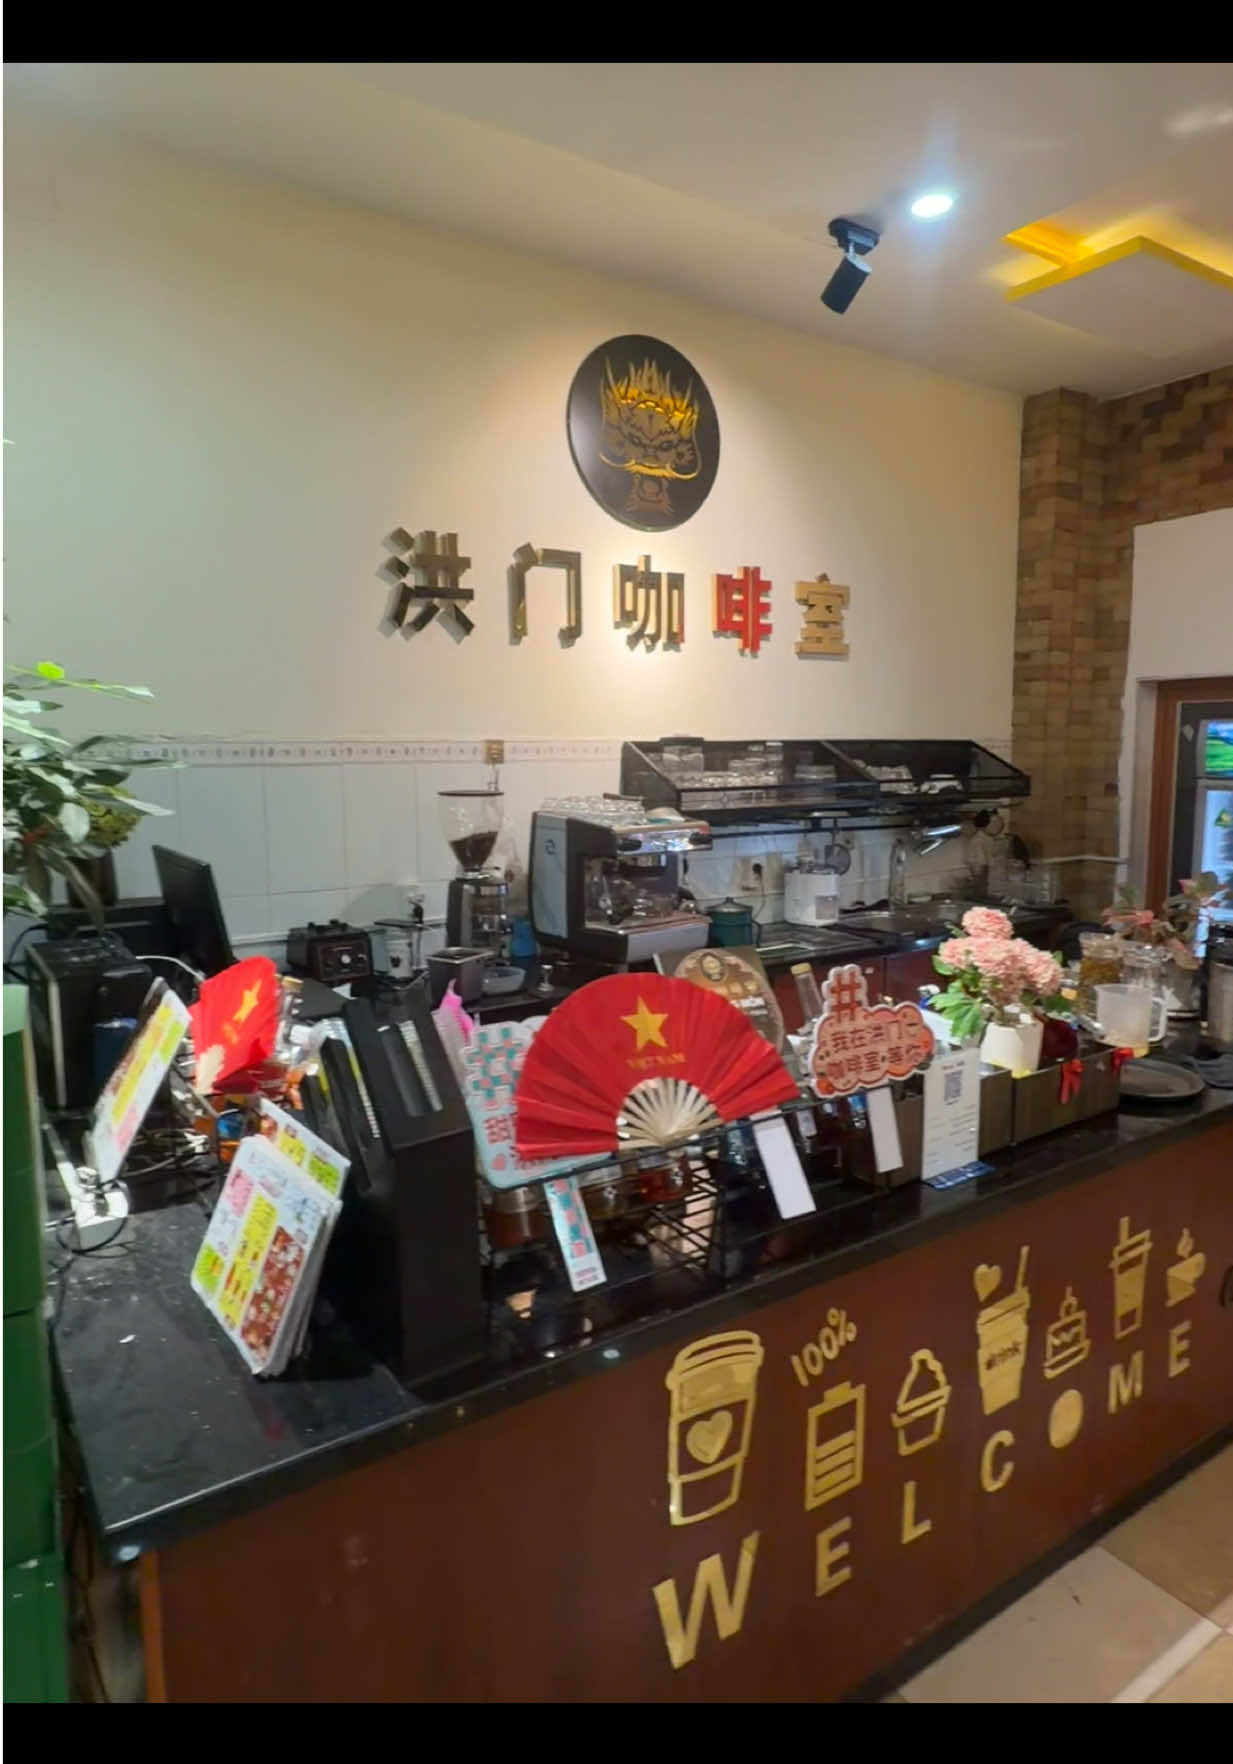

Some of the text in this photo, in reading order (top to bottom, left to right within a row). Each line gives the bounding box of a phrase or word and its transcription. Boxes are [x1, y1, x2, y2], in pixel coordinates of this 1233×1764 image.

[376, 527, 850, 661] 洪门咖啡室
[790, 1307, 857, 1387] 100%
